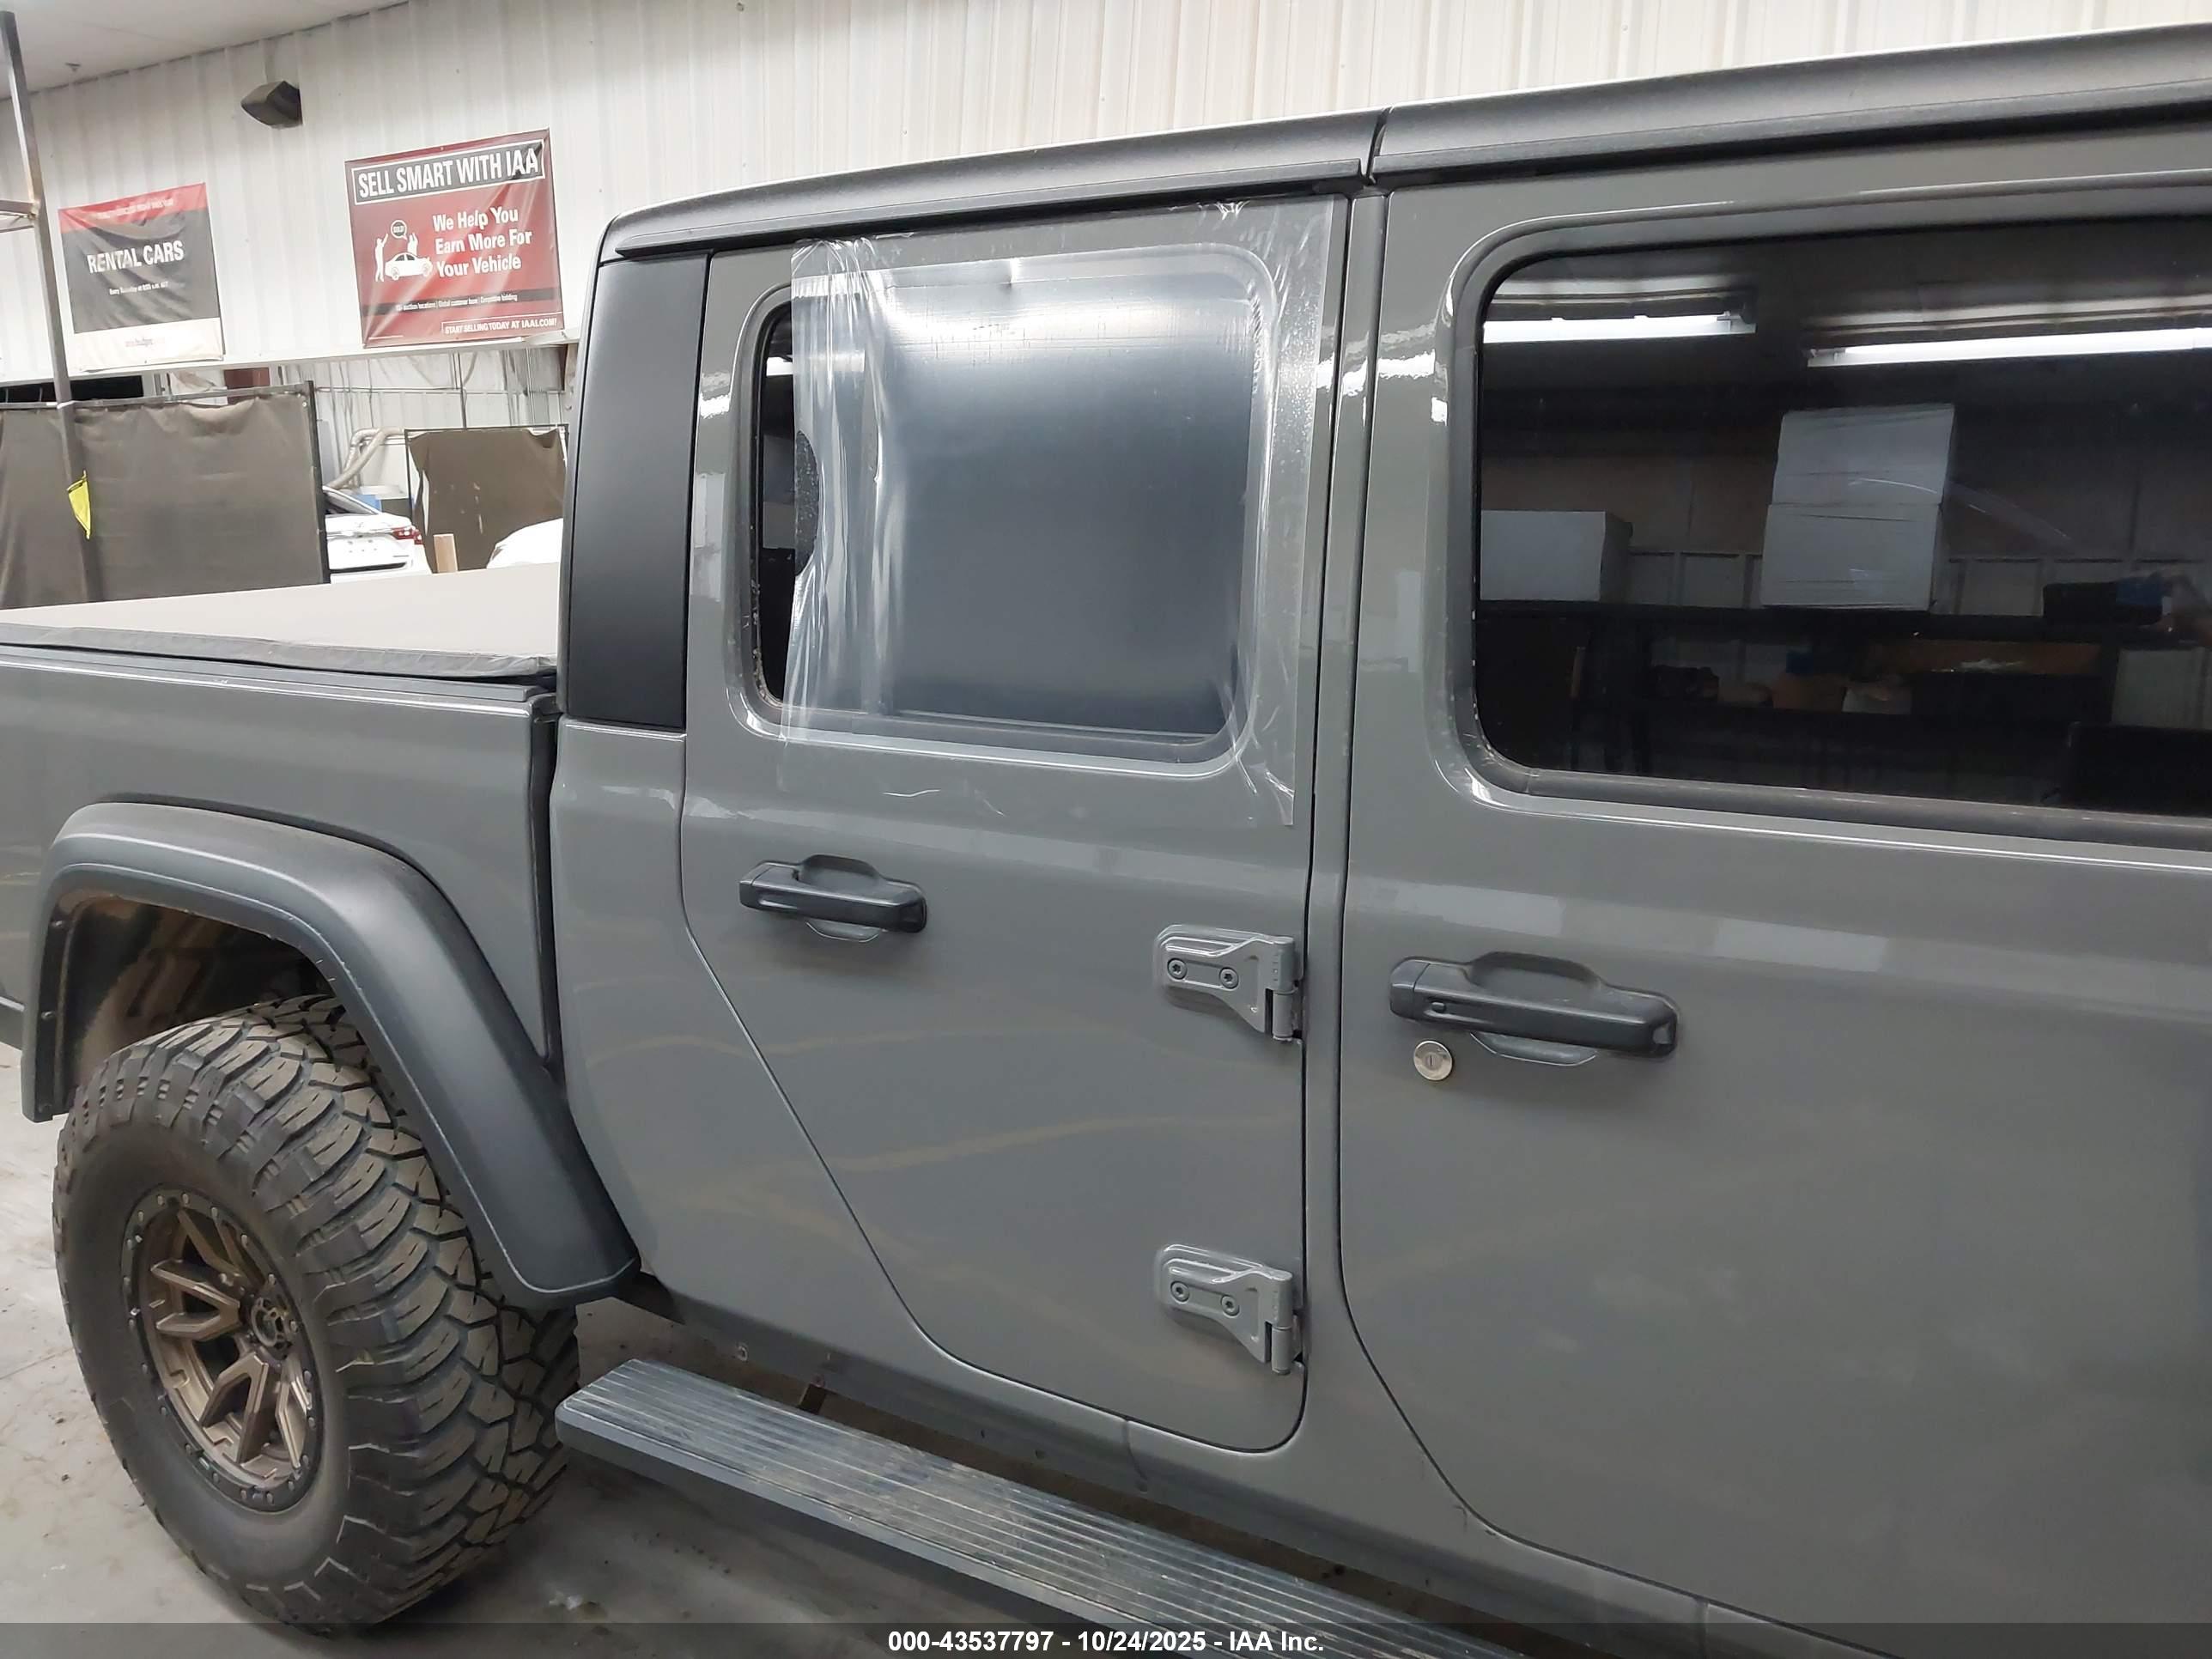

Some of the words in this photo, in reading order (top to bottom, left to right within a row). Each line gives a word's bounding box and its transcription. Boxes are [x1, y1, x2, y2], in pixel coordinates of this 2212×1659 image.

[358, 171, 394, 198] SELL
[396, 161, 454, 191] SMART
[456, 153, 502, 184] WITH
[506, 148, 538, 177] IAA
[433, 214, 454, 232] We
[458, 210, 489, 230] Help
[489, 206, 519, 224] You
[435, 238, 465, 255] Earn
[468, 233, 506, 251] More
[509, 228, 532, 246] For
[87, 248, 143, 274] RENTAL
[143, 240, 185, 265] CARS
[437, 260, 470, 278] Your
[471, 252, 522, 274] Vehicle
[445, 325, 463, 334] START
[463, 323, 488, 332] SELLING
[488, 321, 510, 330] TODAY
[511, 320, 520, 329] AT
